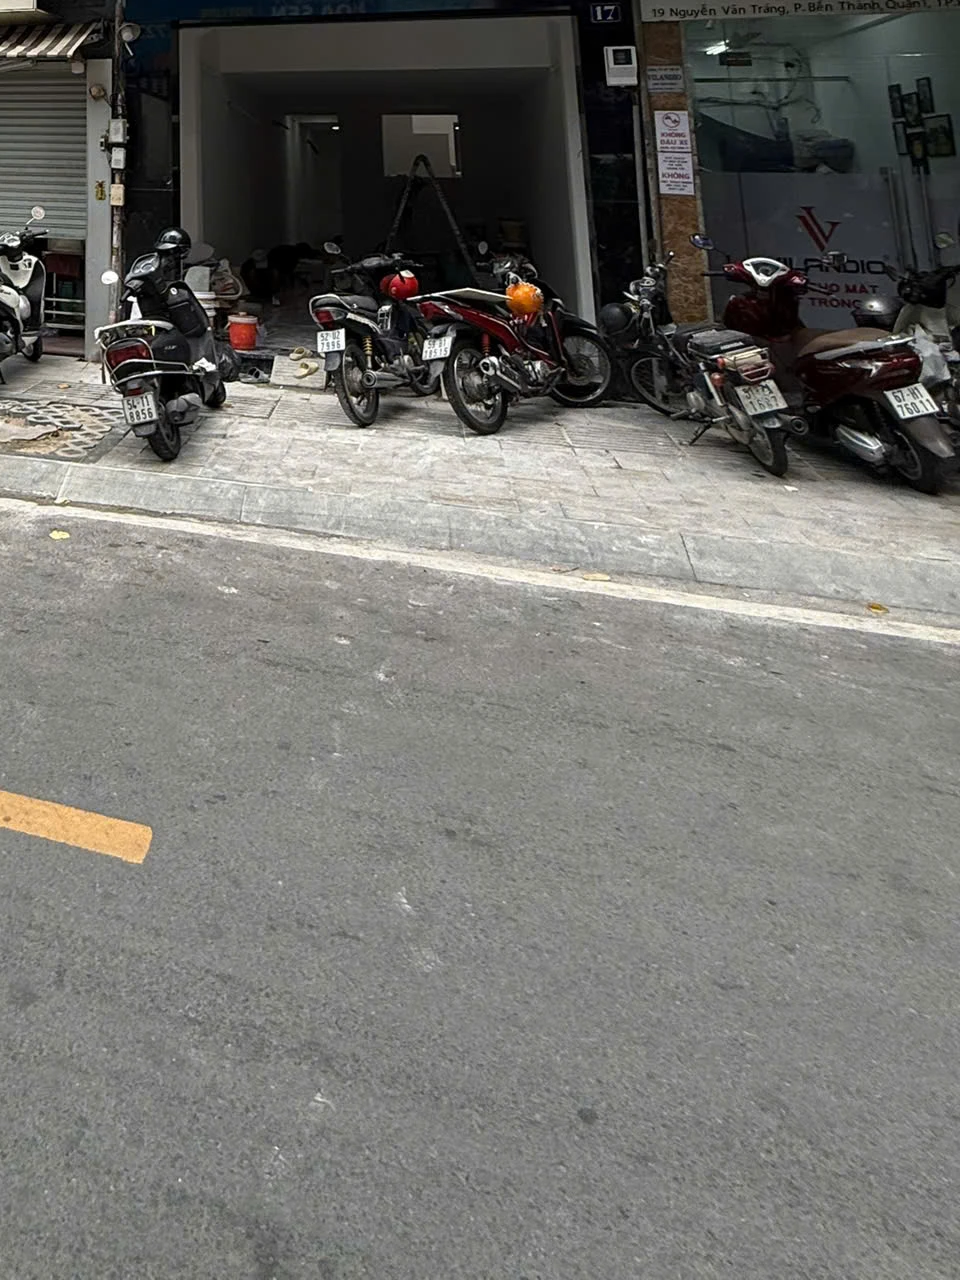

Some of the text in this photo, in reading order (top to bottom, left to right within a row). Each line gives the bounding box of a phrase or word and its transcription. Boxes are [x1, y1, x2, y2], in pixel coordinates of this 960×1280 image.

[595, 5, 616, 20] 17
[652, 8, 665, 18] 19
[669, 3, 717, 19] Nguyễn
[721, 4, 746, 15] Văn
[661, 171, 690, 180] KHÔNG
[129, 408, 154, 422] 8856
